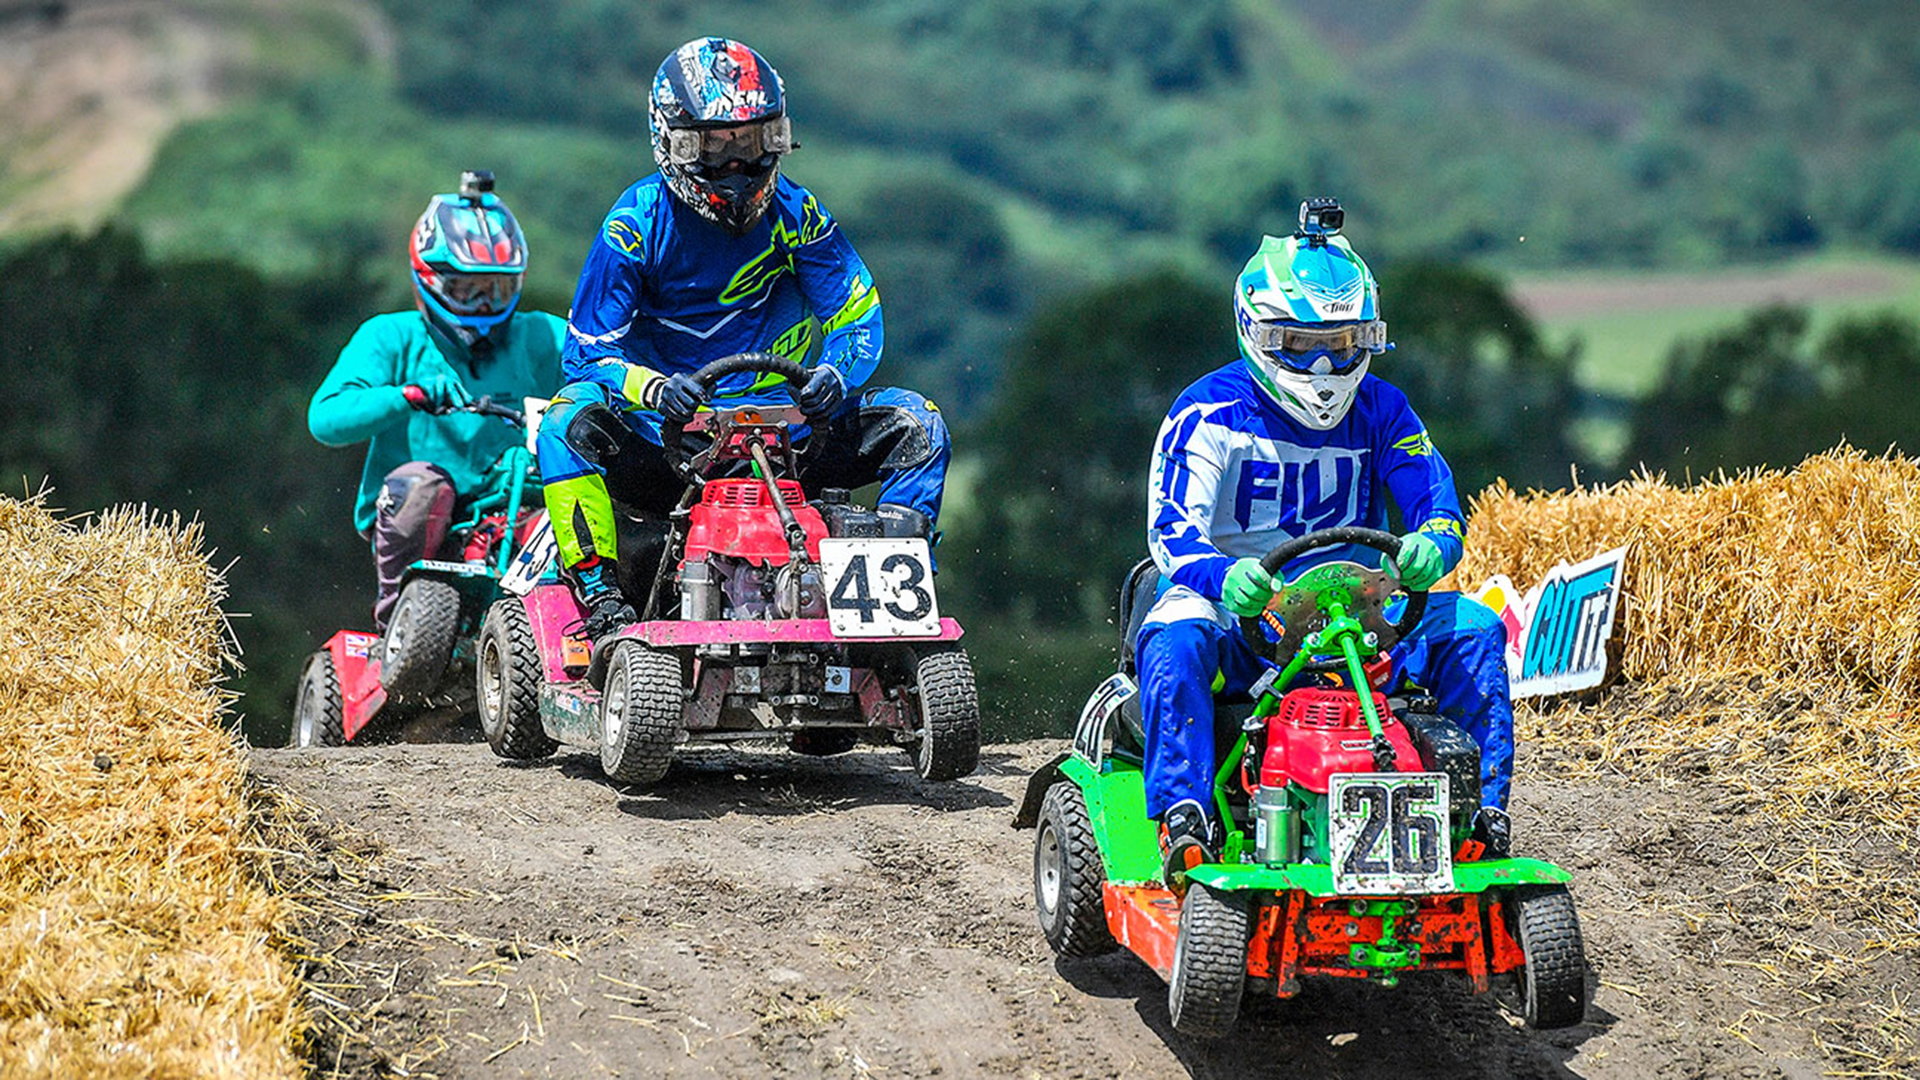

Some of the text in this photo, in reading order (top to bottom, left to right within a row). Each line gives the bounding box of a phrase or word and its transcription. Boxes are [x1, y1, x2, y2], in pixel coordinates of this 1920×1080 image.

[829, 553, 933, 623] 43
[1523, 564, 1615, 679] CUT IT
[1341, 784, 1440, 876] 26
